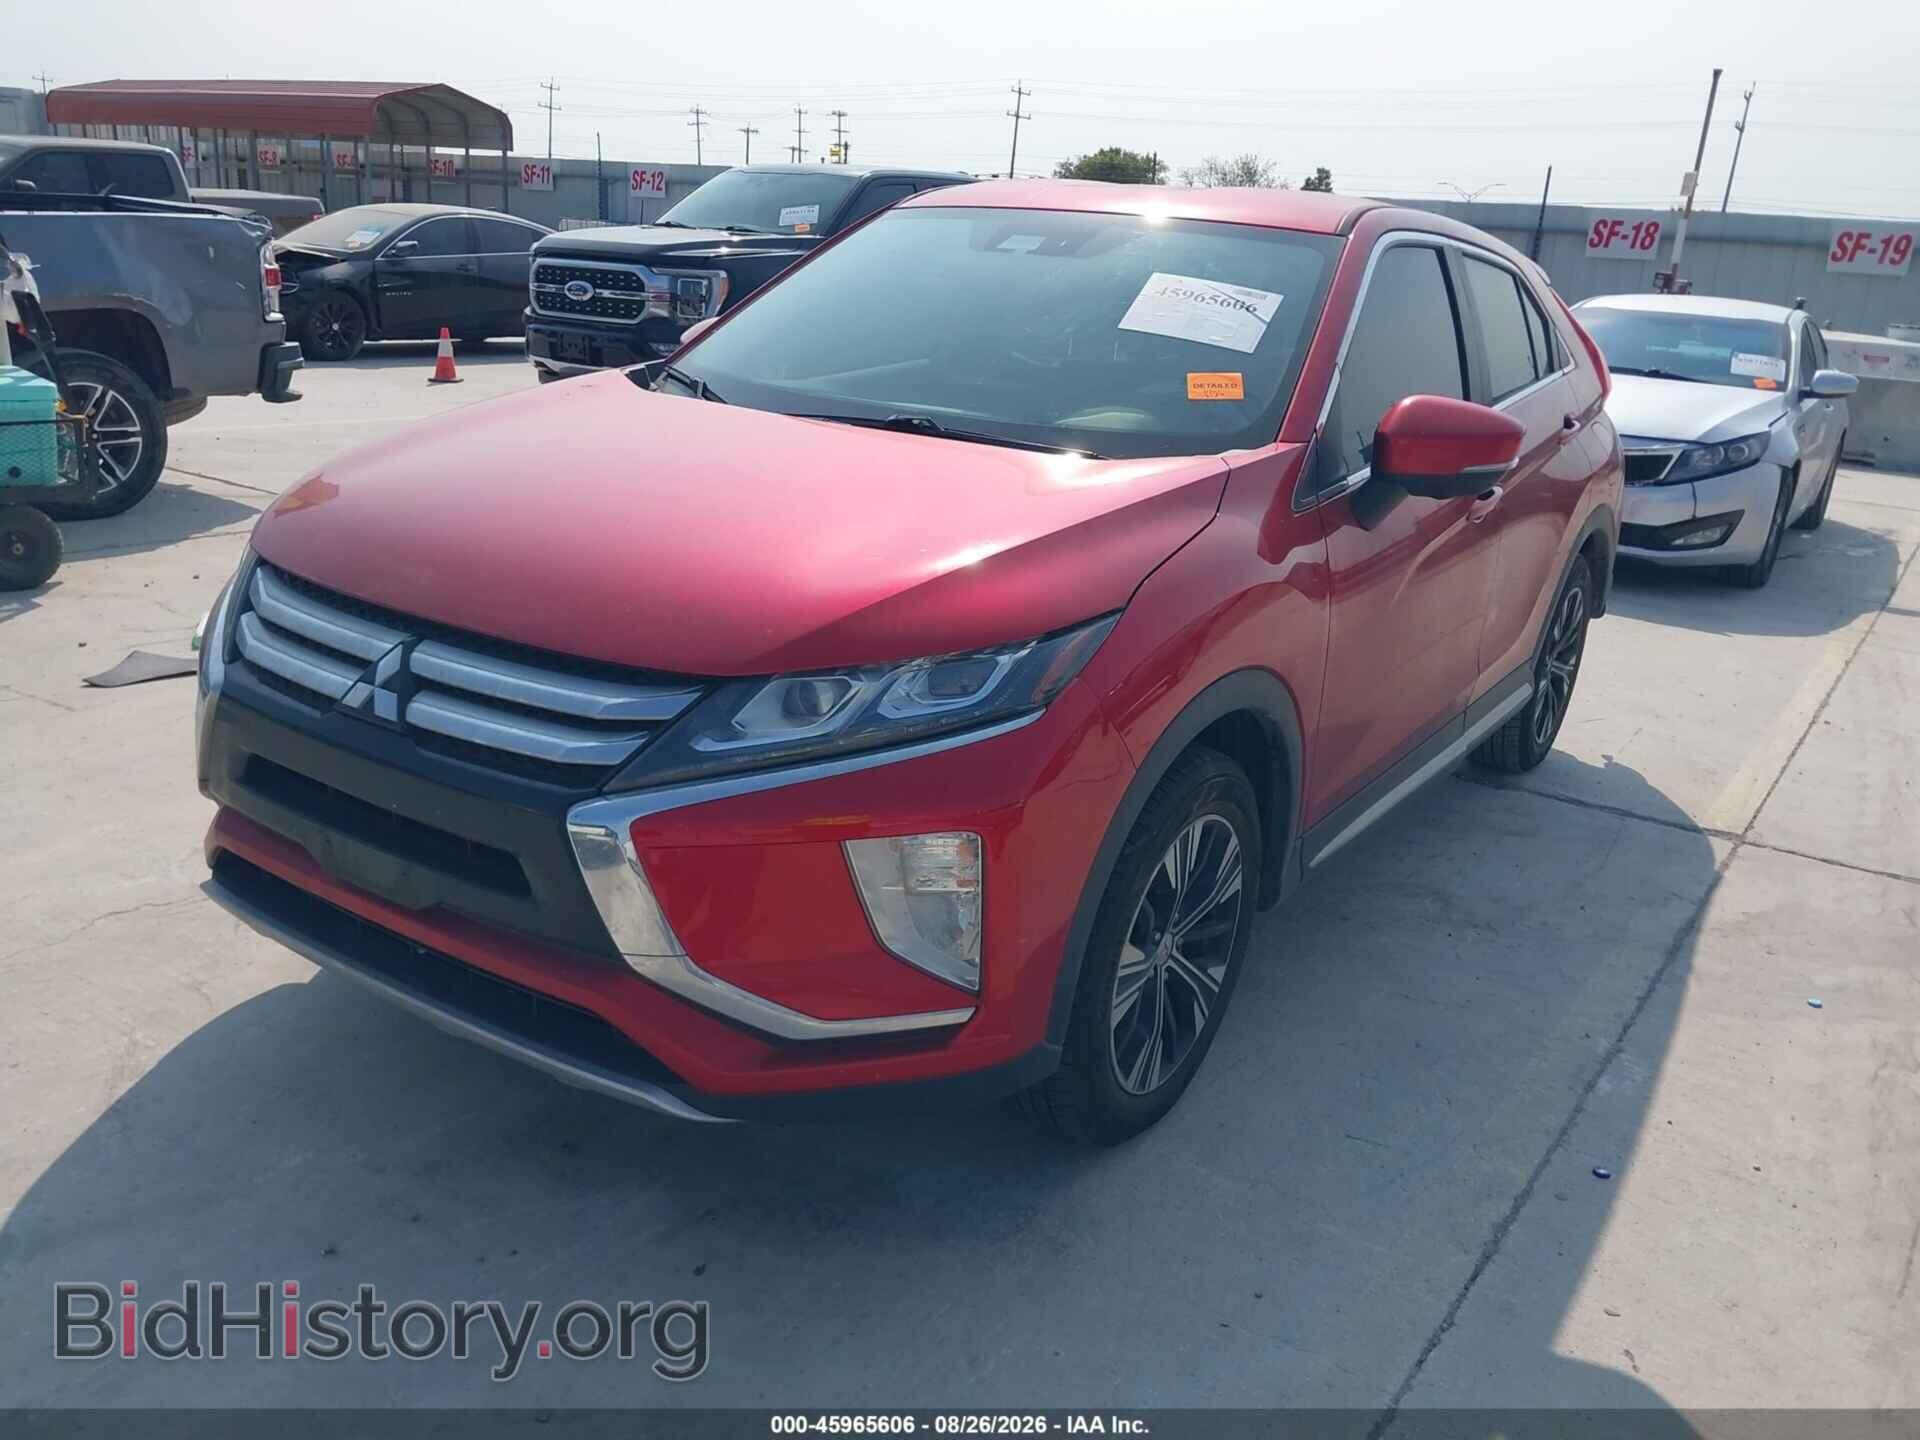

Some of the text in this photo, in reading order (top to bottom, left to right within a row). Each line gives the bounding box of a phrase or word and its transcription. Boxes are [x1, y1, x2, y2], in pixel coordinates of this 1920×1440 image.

[523, 163, 551, 184] SF-11
[631, 169, 664, 192] SF-12
[1588, 218, 1660, 250] SF-18
[1830, 231, 1913, 266] SF-19
